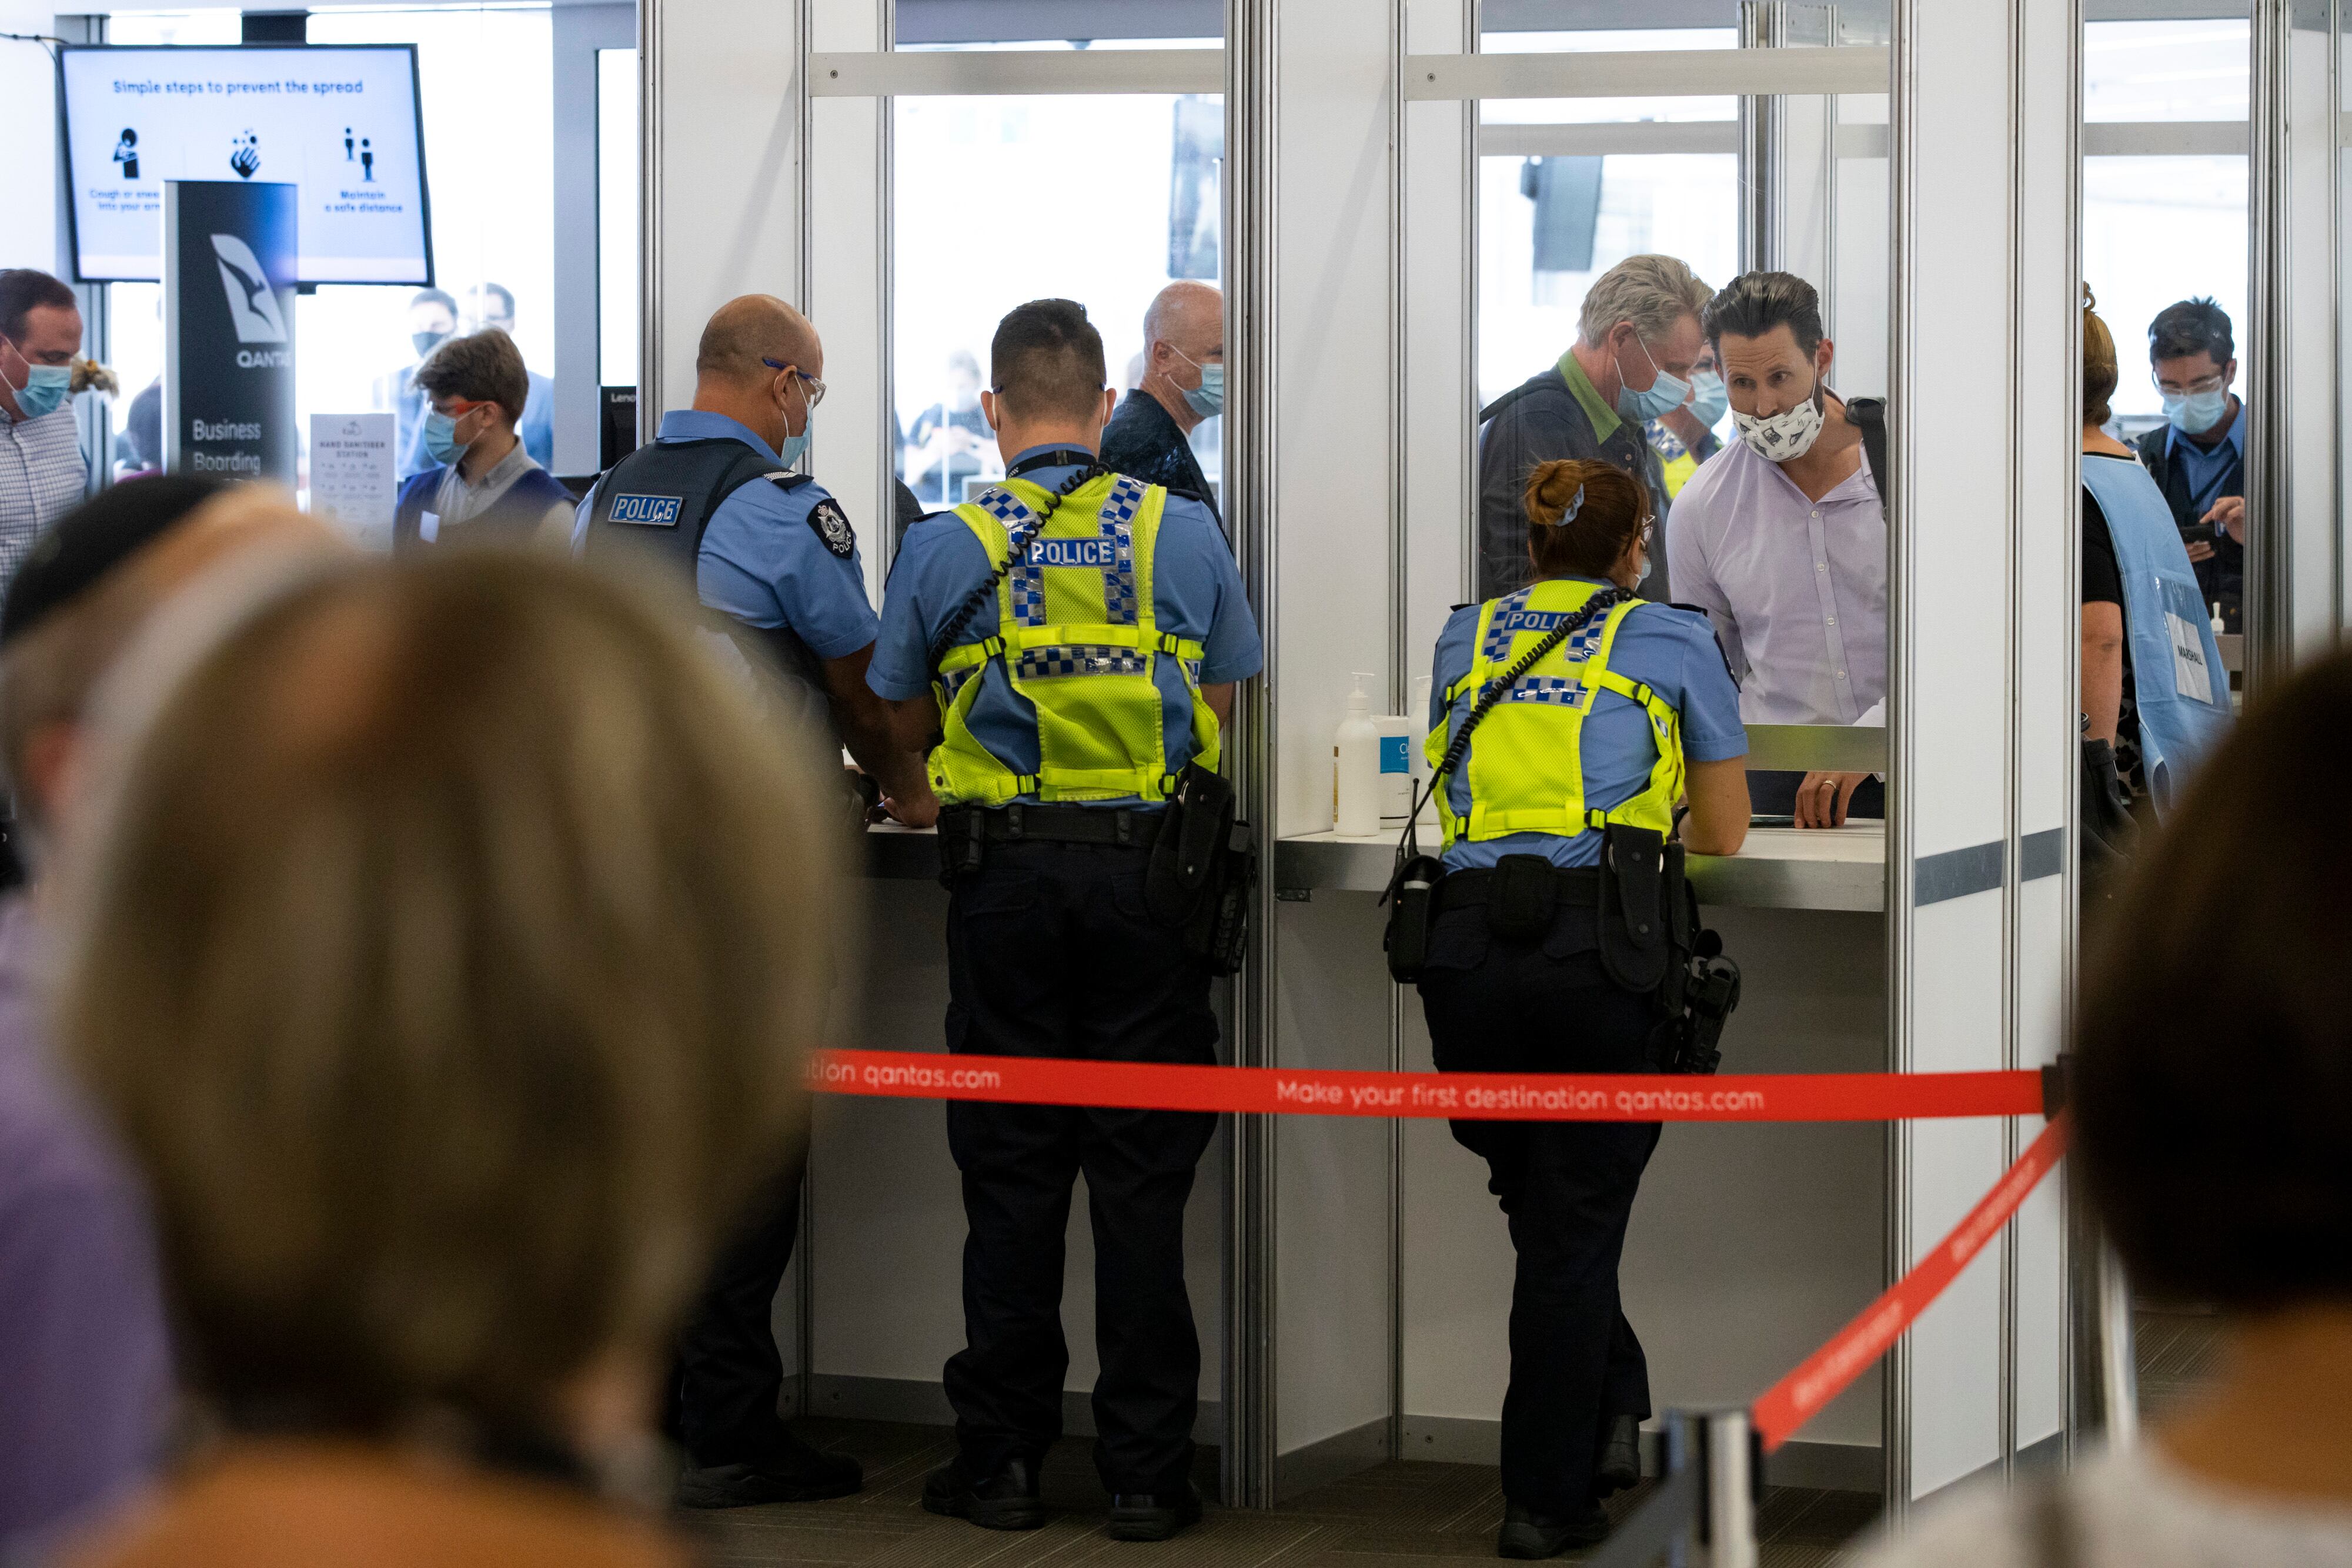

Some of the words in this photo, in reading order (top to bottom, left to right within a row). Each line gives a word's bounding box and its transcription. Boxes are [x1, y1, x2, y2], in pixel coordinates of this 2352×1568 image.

[113, 80, 161, 96] Simple
[165, 81, 203, 96] steps
[208, 81, 223, 93] to
[226, 81, 281, 97] prevent
[285, 79, 308, 93] the
[313, 79, 363, 97] spread
[89, 188, 119, 200] Cough
[340, 190, 386, 200] Maintain
[120, 203, 140, 213] your
[334, 203, 355, 212] safe
[359, 203, 403, 212] distance
[611, 393, 637, 403] Leno
[193, 418, 262, 440] Business
[193, 450, 261, 475] Boarding
[614, 498, 676, 520] POLICE
[833, 530, 851, 553] POLICE
[1031, 541, 1111, 564] POLICE
[2177, 644, 2203, 666] MARSHALL
[863, 1065, 1001, 1089] qantas.com
[1277, 1080, 1344, 1104] Make
[1350, 1086, 1404, 1109] your
[1412, 1082, 1459, 1108] first
[1465, 1084, 1608, 1110] destination
[1615, 1089, 1764, 1115] qantas.com
